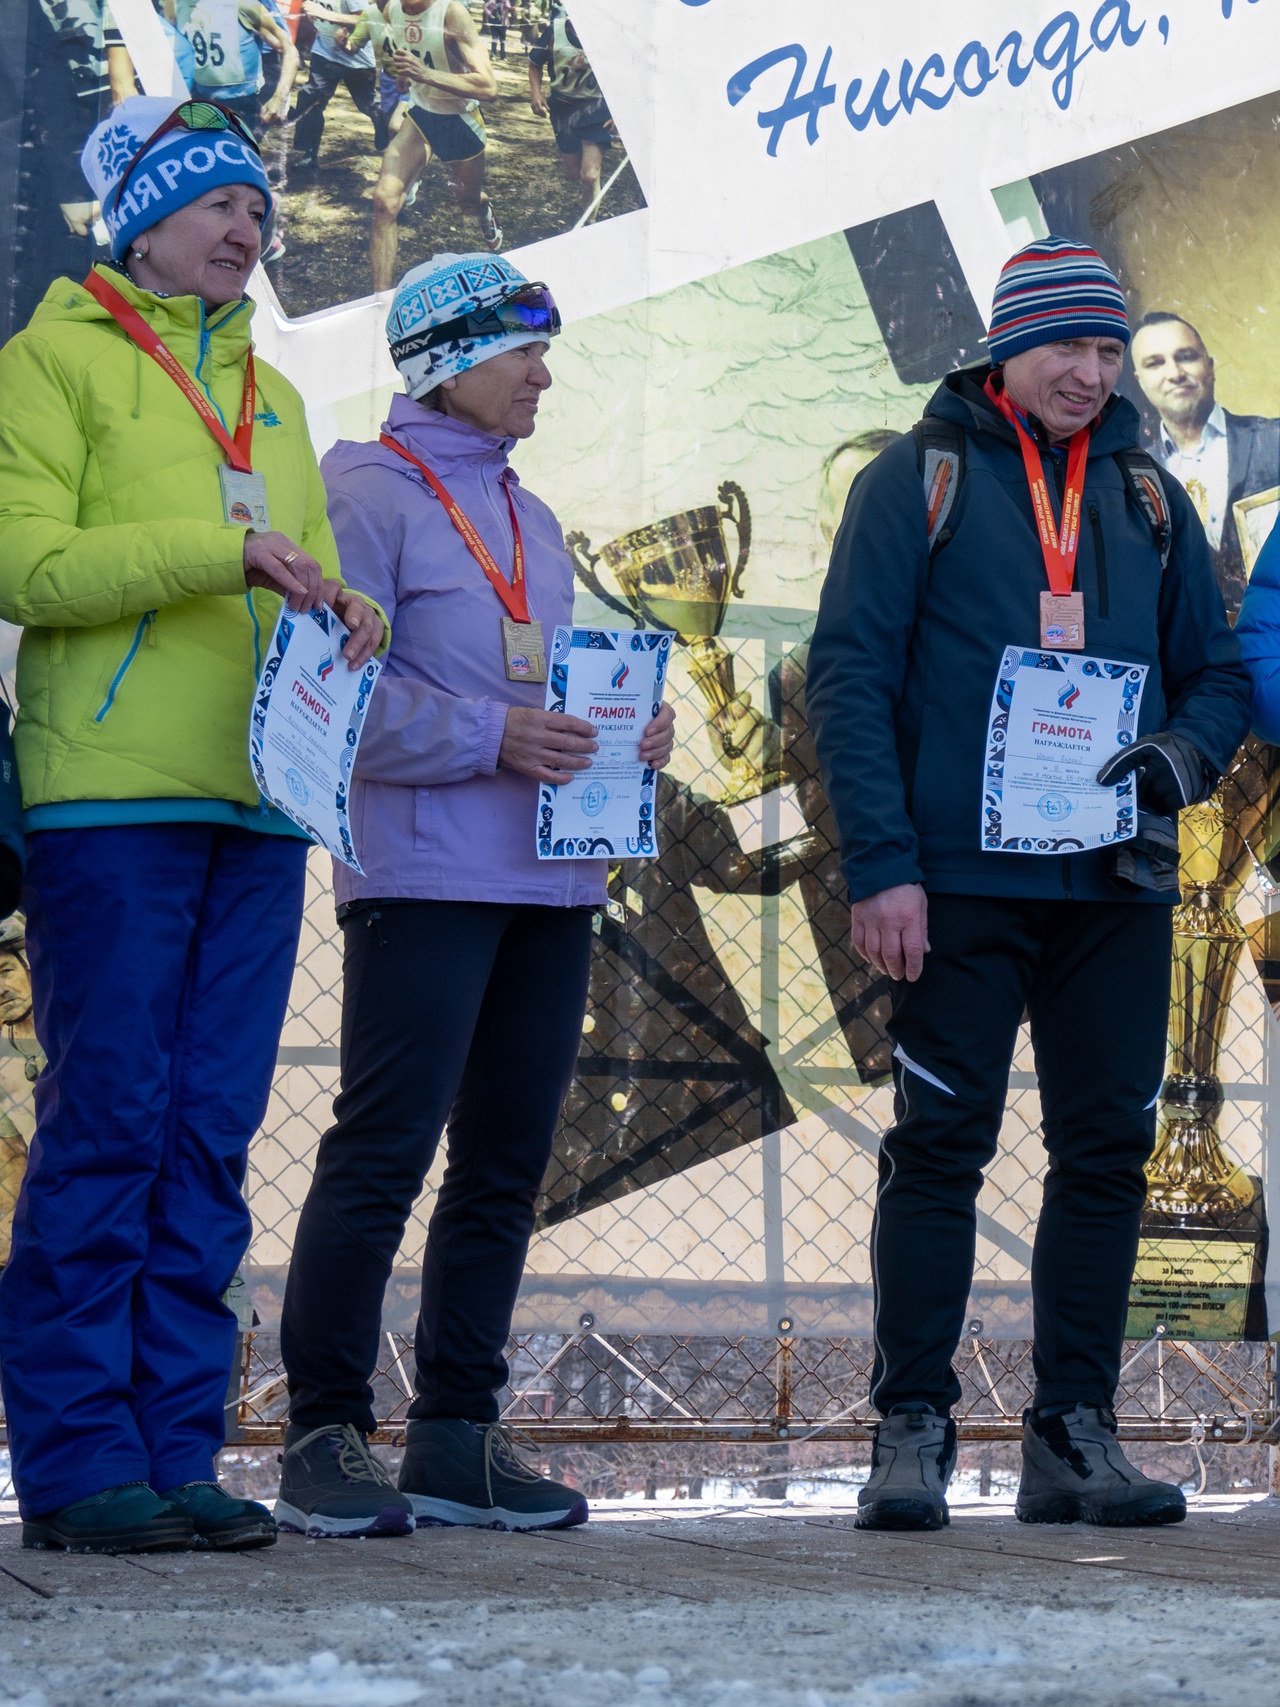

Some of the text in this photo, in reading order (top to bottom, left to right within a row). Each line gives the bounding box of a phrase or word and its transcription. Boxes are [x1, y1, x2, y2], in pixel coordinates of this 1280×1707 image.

[727, 0, 1169, 158] Никогда,
[394, 332, 434, 358] WAY
[1068, 623, 1079, 641] 3
[292, 680, 331, 726] ГРАМОТА
[588, 706, 636, 719] ГРАМОТА
[1031, 721, 1093, 741] ГРАМОТА
[1034, 739, 1091, 752] НАГРАЖДАЕТСЯ
[1140, 1289, 1182, 1297] Челябинской
[1164, 1280, 1198, 1288] ветеранов
